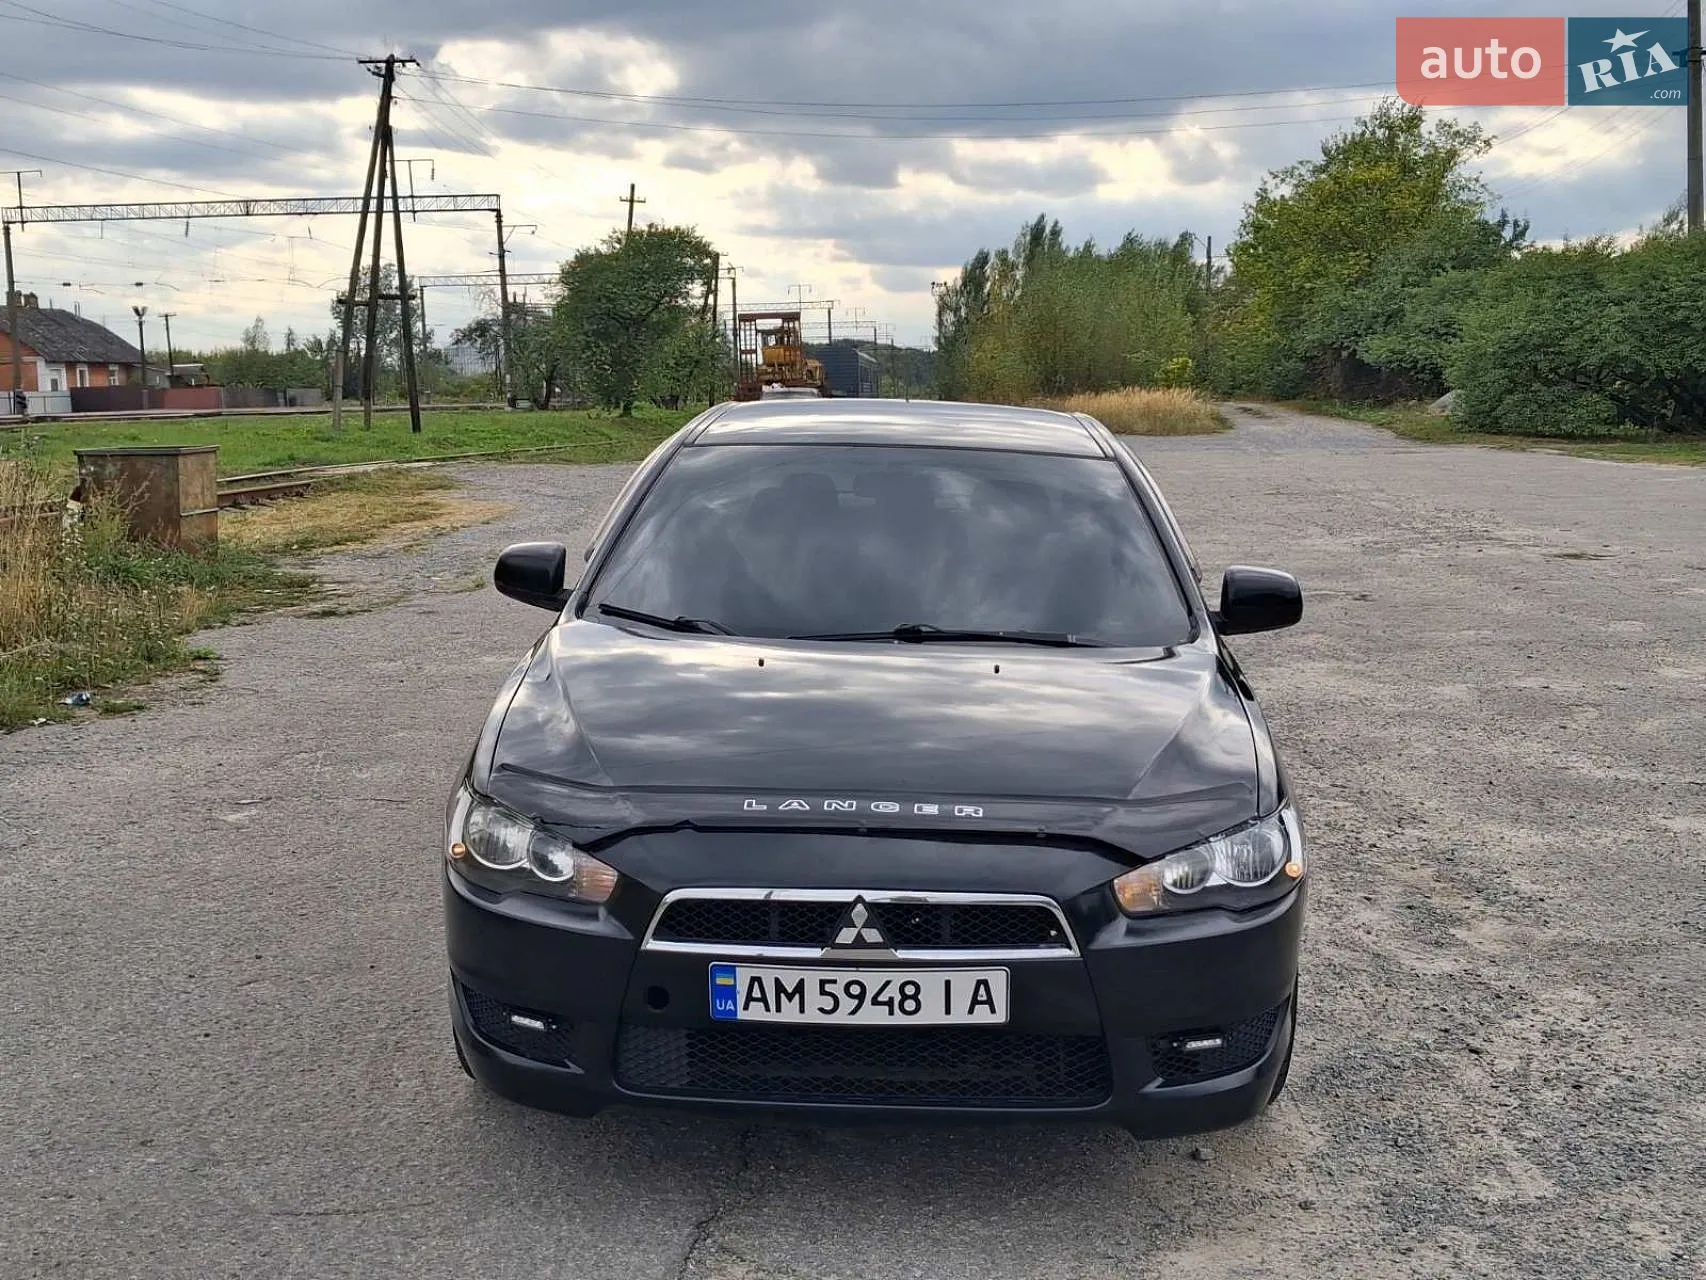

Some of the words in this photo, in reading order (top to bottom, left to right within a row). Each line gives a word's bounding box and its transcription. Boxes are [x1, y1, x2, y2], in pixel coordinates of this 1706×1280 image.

[715, 999, 735, 1012] UA
[742, 975, 806, 1014] AM
[817, 978, 922, 1017] 5948
